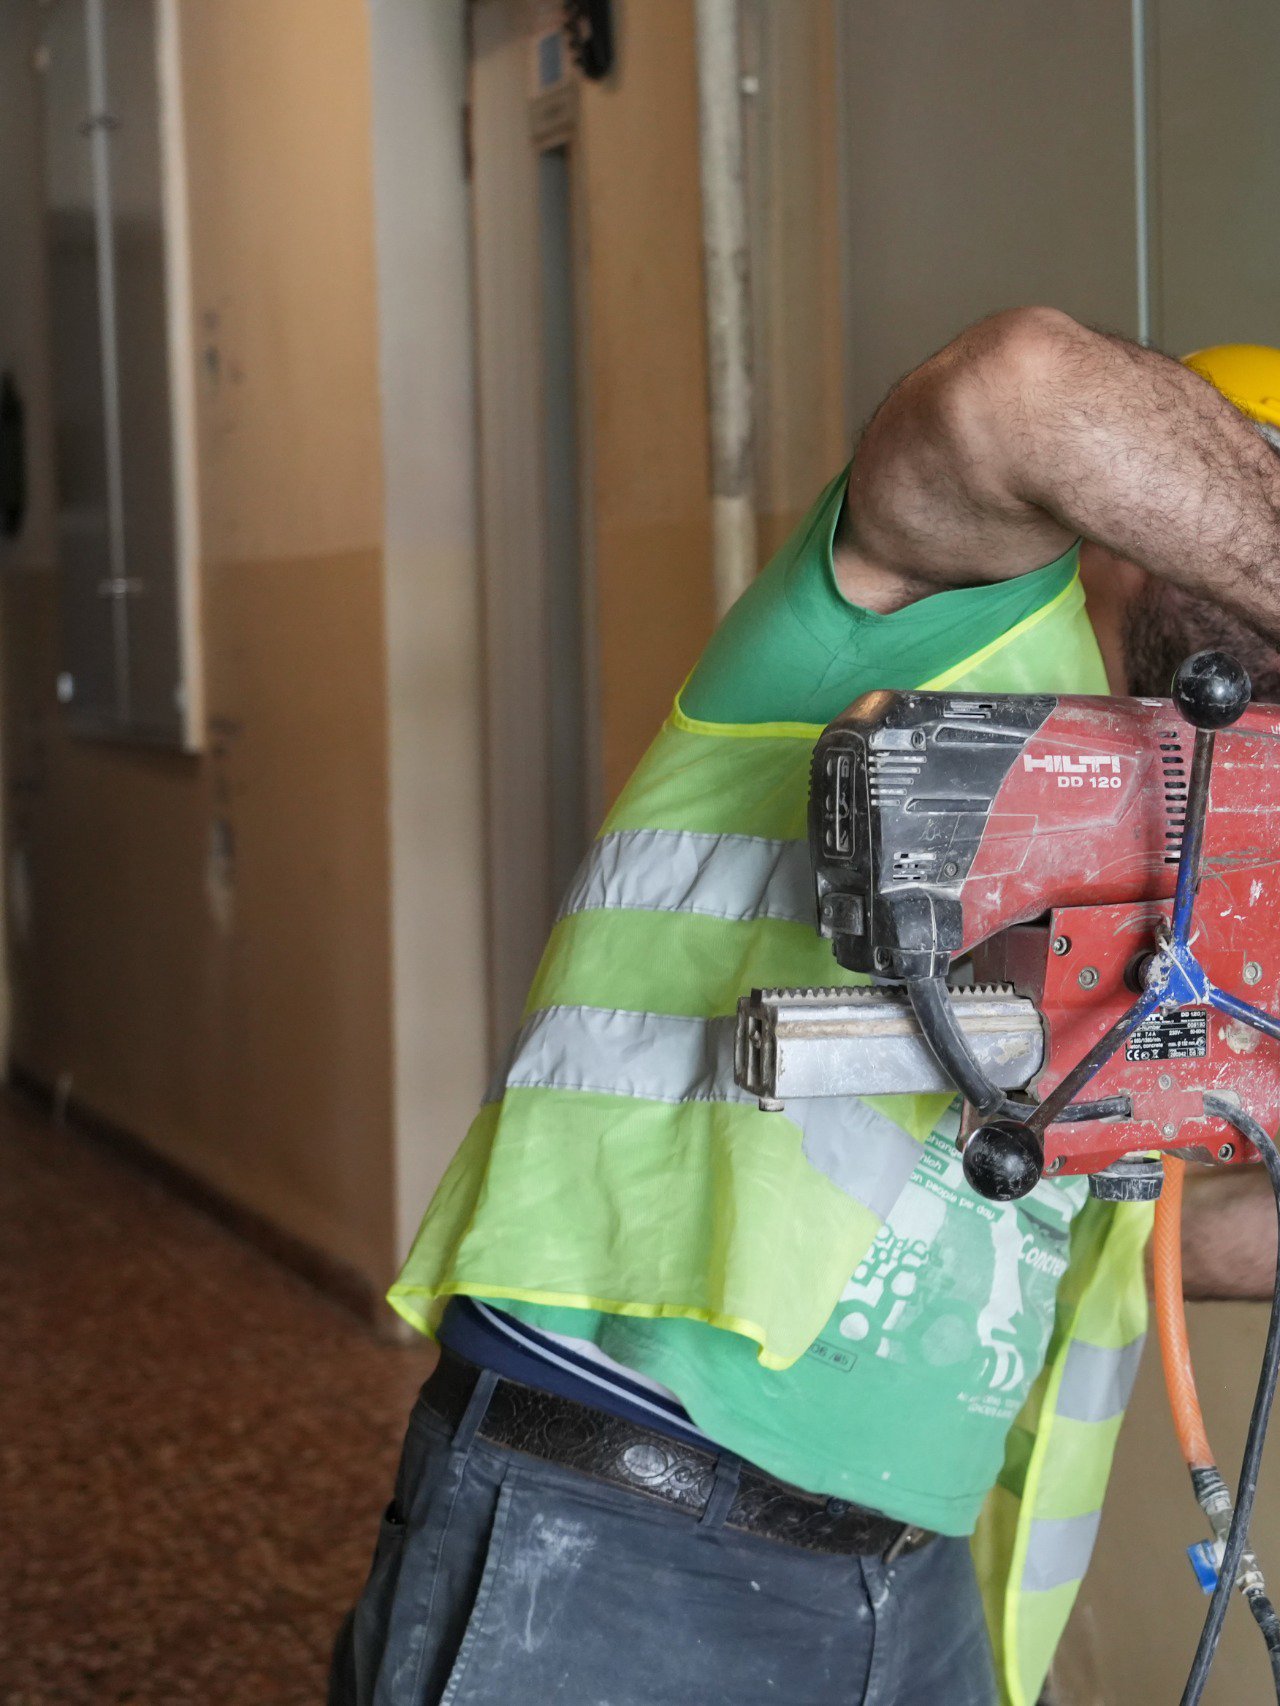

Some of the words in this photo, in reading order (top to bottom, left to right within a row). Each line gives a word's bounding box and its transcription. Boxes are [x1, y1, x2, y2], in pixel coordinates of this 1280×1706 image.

[1023, 754, 1121, 773] HILTI
[1057, 776, 1084, 788] DD
[1089, 776, 1122, 789] 120
[926, 1179, 959, 1204] people
[959, 1195, 977, 1211] per
[976, 1202, 997, 1220] day
